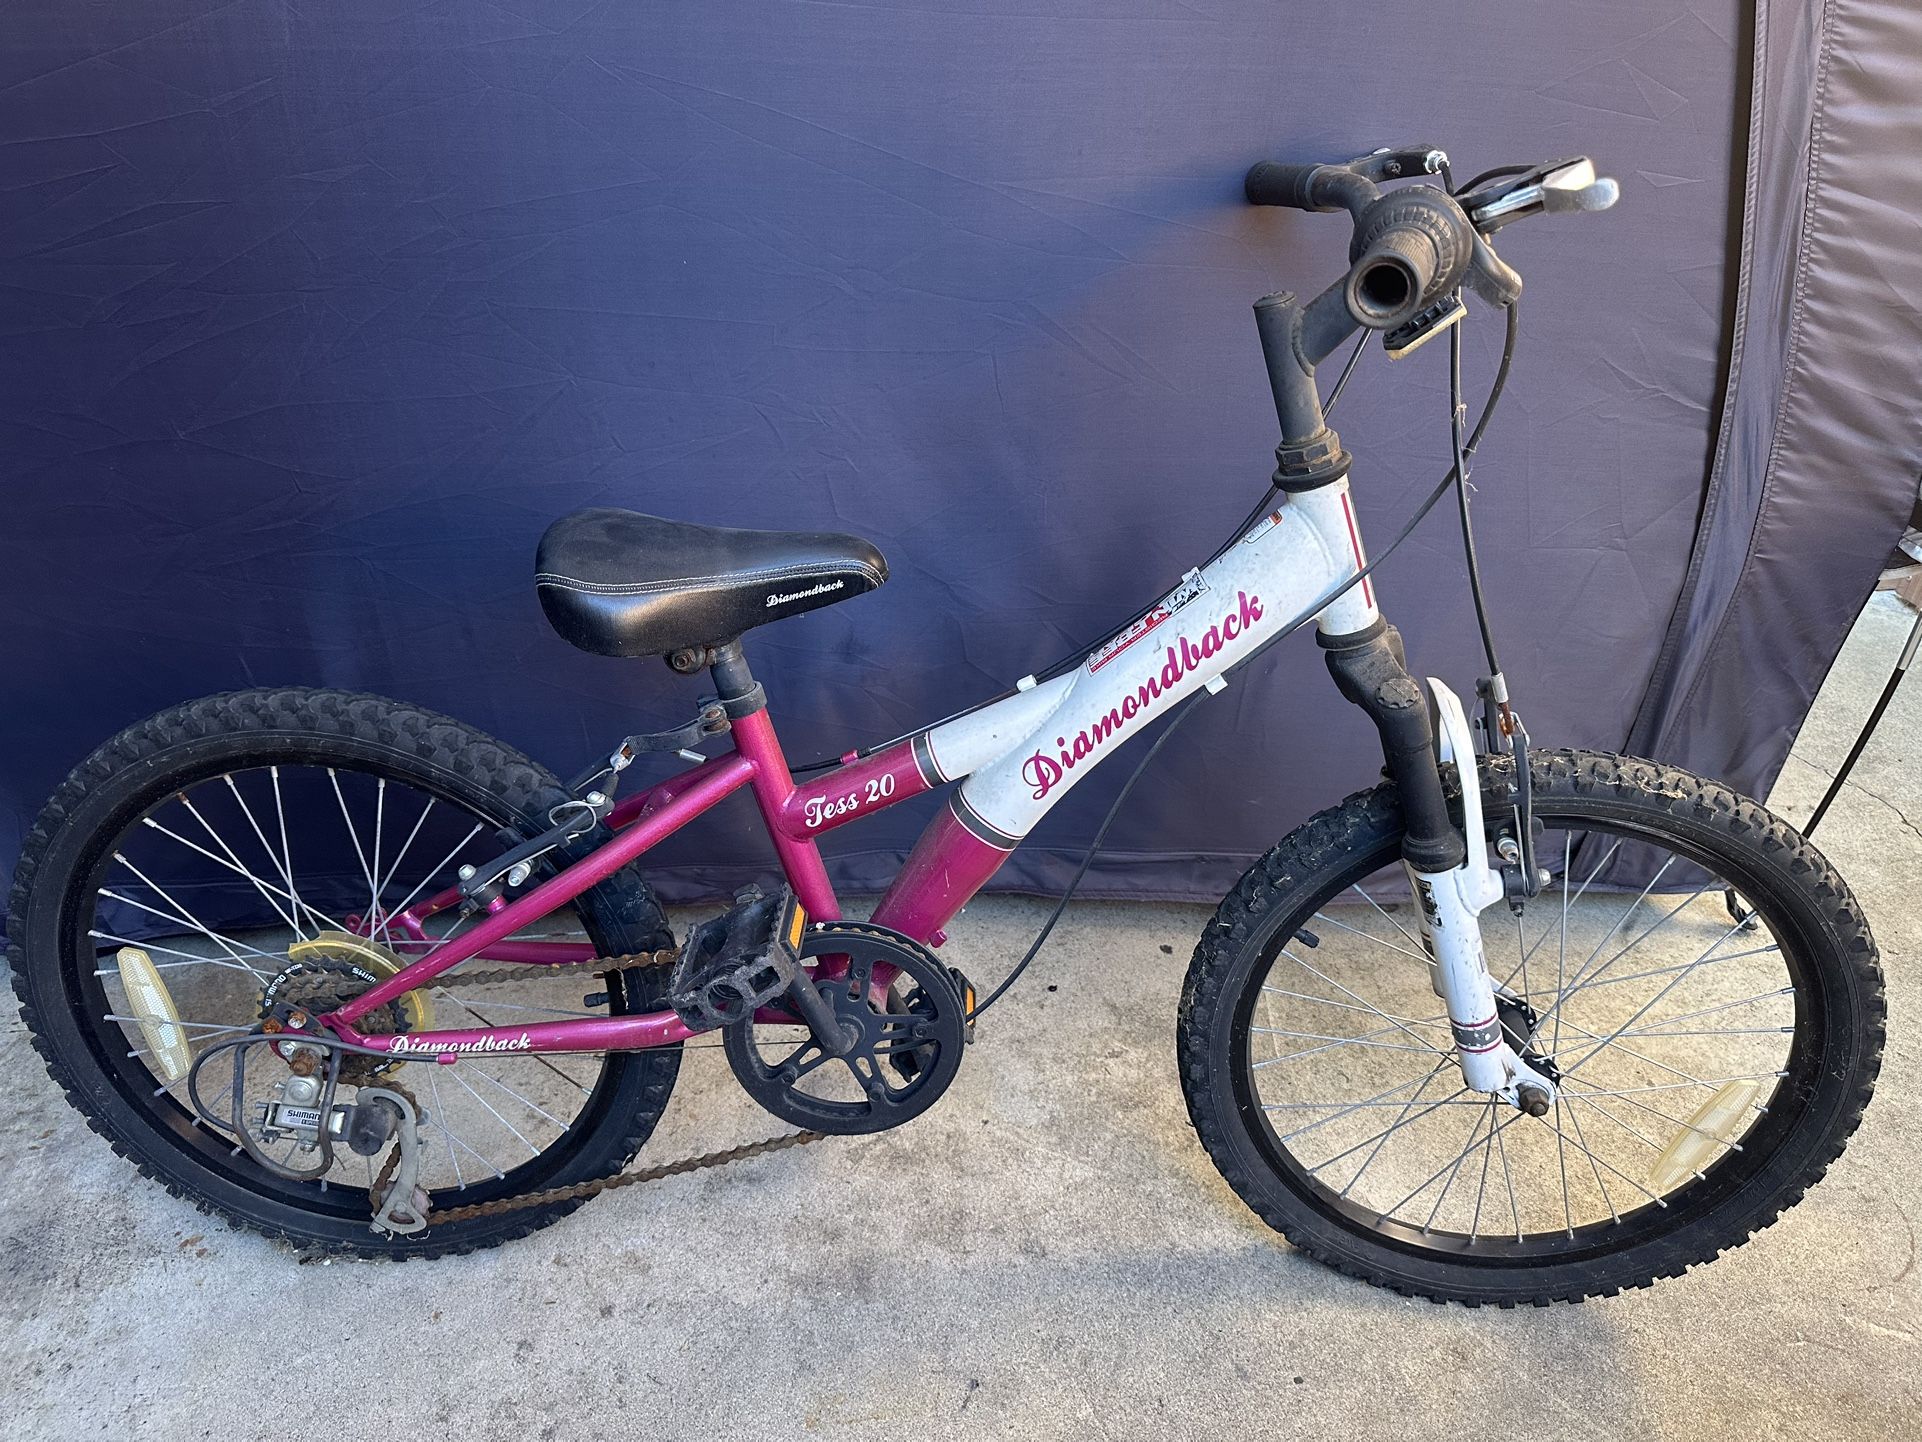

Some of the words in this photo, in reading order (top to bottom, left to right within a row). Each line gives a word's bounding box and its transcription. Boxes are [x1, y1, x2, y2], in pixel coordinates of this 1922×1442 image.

[766, 580, 844, 607] Diamondback
[1022, 591, 1264, 800] Diamondback
[804, 795, 860, 827] Tess
[865, 774, 895, 804] 20
[352, 967, 377, 983] SHIM
[387, 1033, 531, 1053] Diamondback
[287, 1109, 320, 1120] SHIMAN
